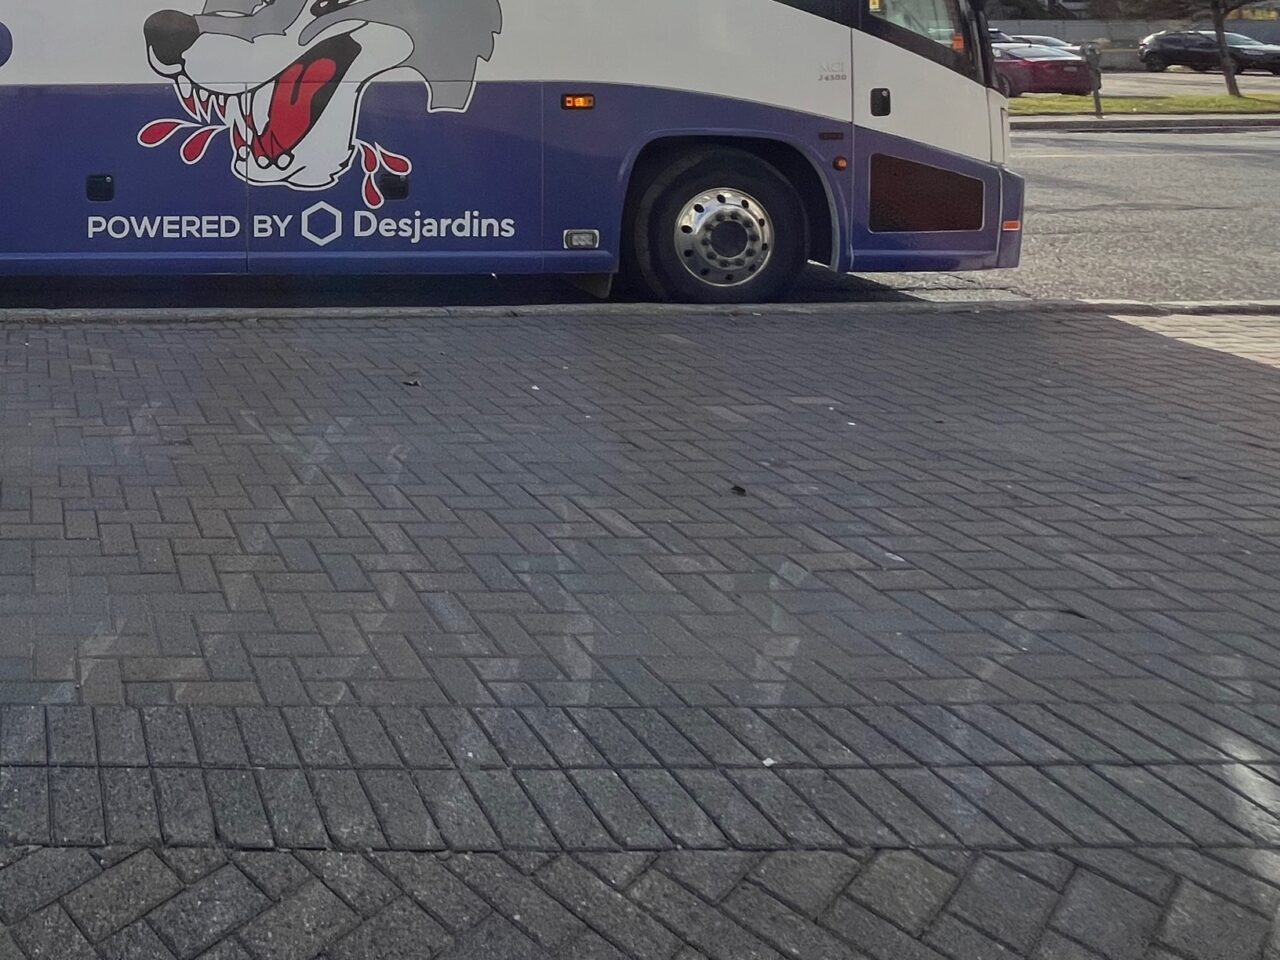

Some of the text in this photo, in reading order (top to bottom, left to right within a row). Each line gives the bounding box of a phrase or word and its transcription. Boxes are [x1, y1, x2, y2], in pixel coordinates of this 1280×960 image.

[86, 210, 516, 244] POWERED BY Desjardins
